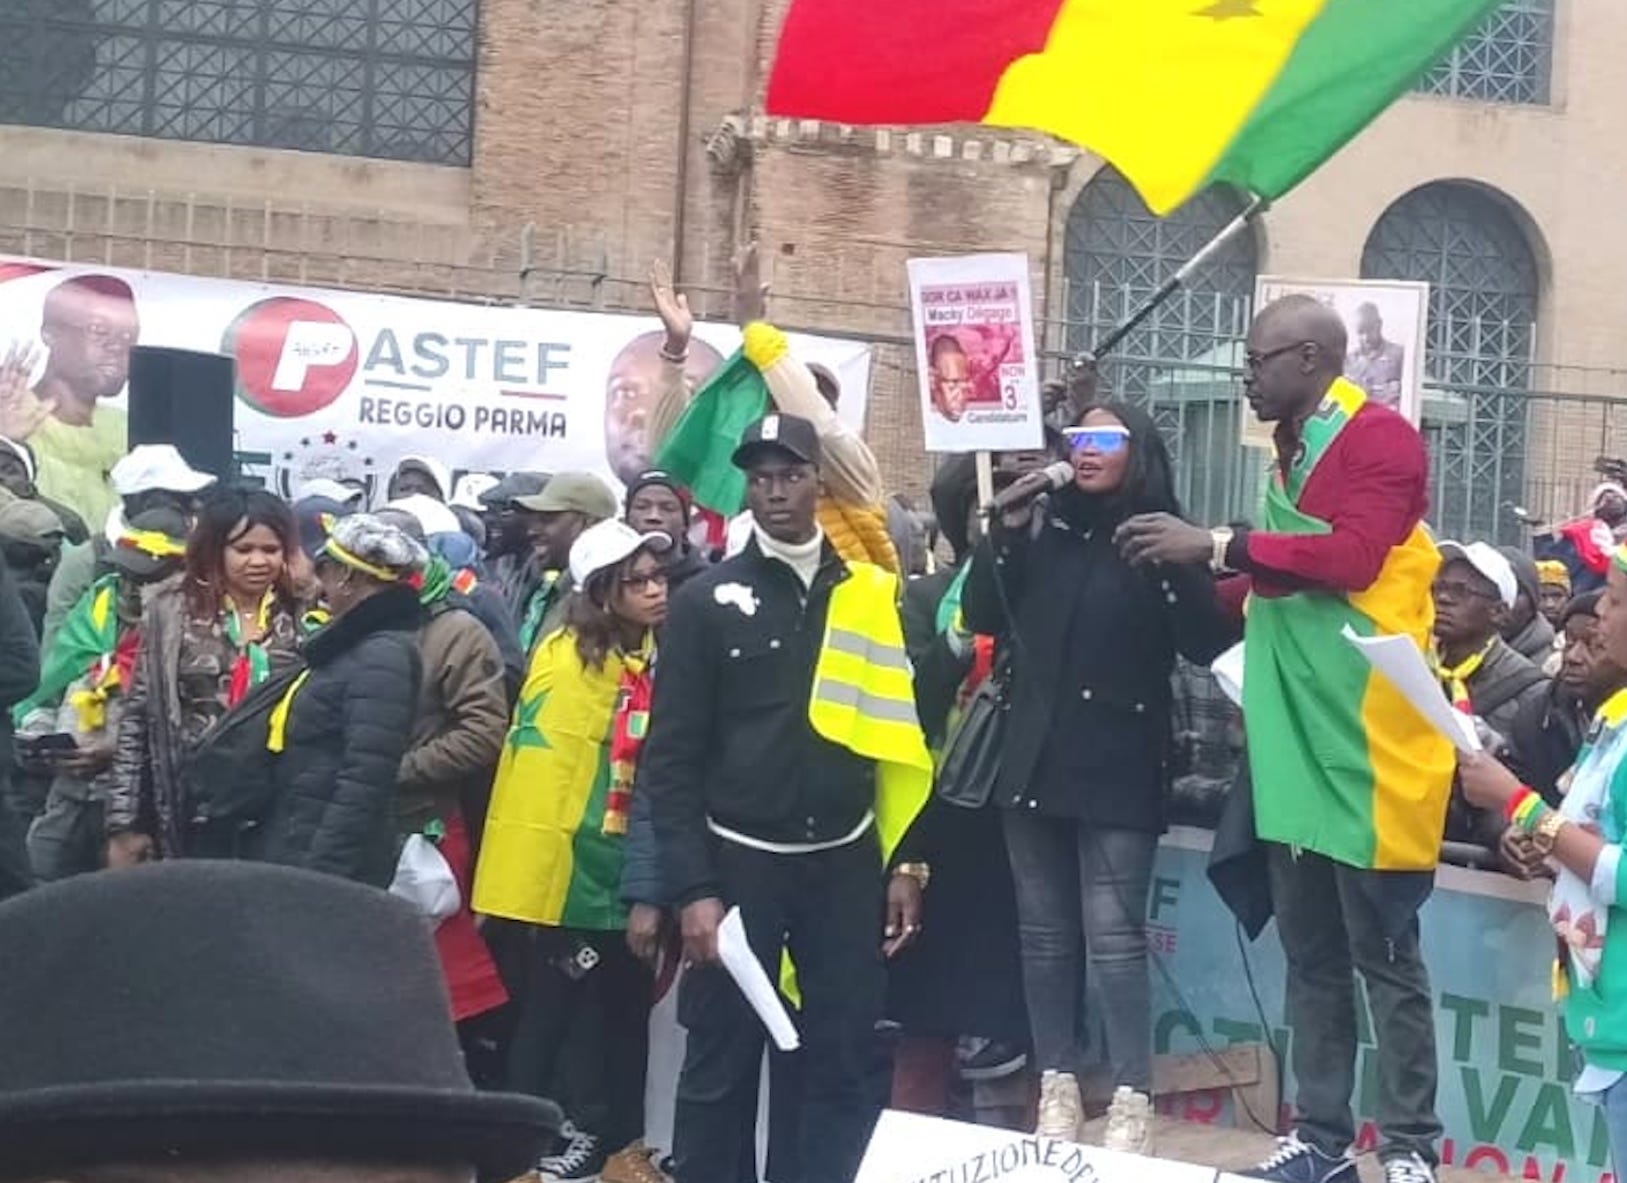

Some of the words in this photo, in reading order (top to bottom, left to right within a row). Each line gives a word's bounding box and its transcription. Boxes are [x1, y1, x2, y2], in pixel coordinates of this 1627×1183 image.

[927, 308, 964, 325] Macky
[1004, 385, 1017, 410] 3
[359, 396, 466, 431] REGGIO
[474, 406, 567, 438] PARMA
